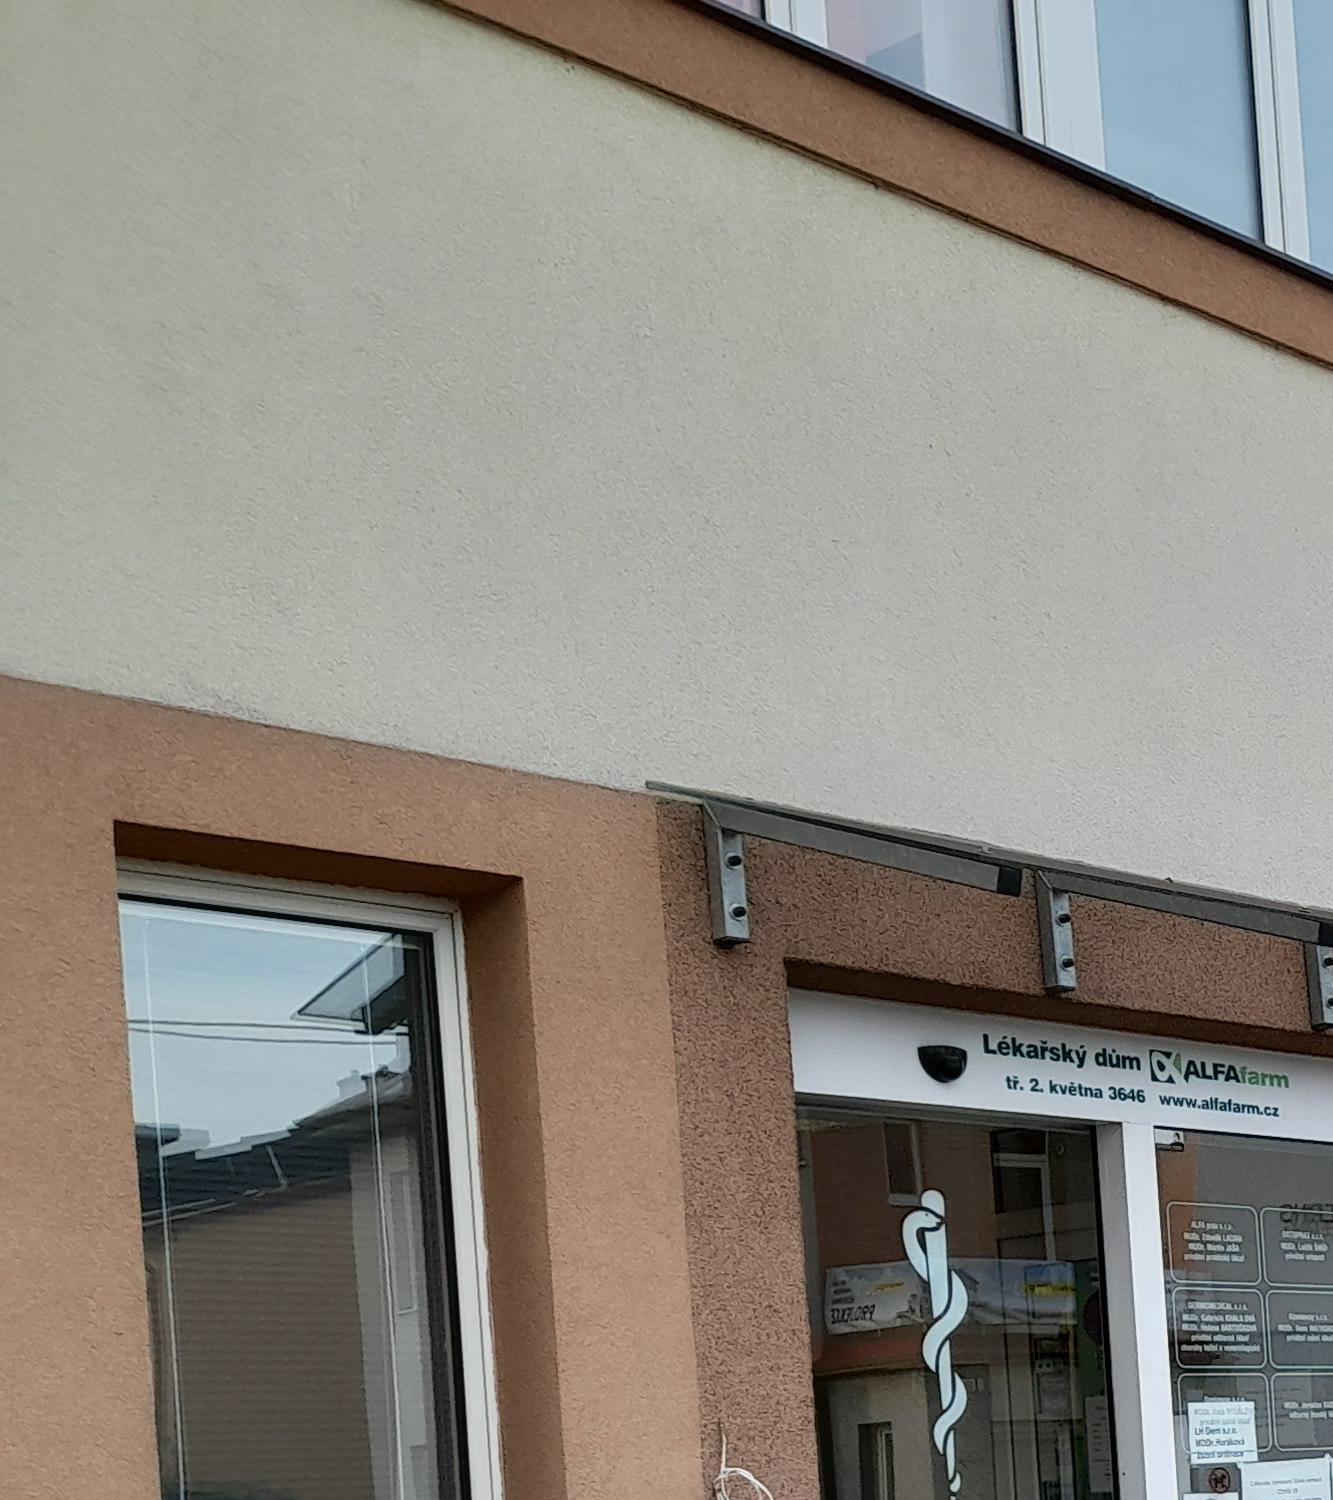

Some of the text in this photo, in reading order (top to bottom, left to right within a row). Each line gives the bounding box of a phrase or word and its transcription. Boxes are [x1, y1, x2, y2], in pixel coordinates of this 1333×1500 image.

[982, 1033, 1142, 1071] Lékařský dům
[1183, 1059, 1290, 1089] ALFAfarm
[1005, 1075, 1146, 1103] tř. 2. května 3646
[1158, 1094, 1280, 1118] www.alfafarm.cz
